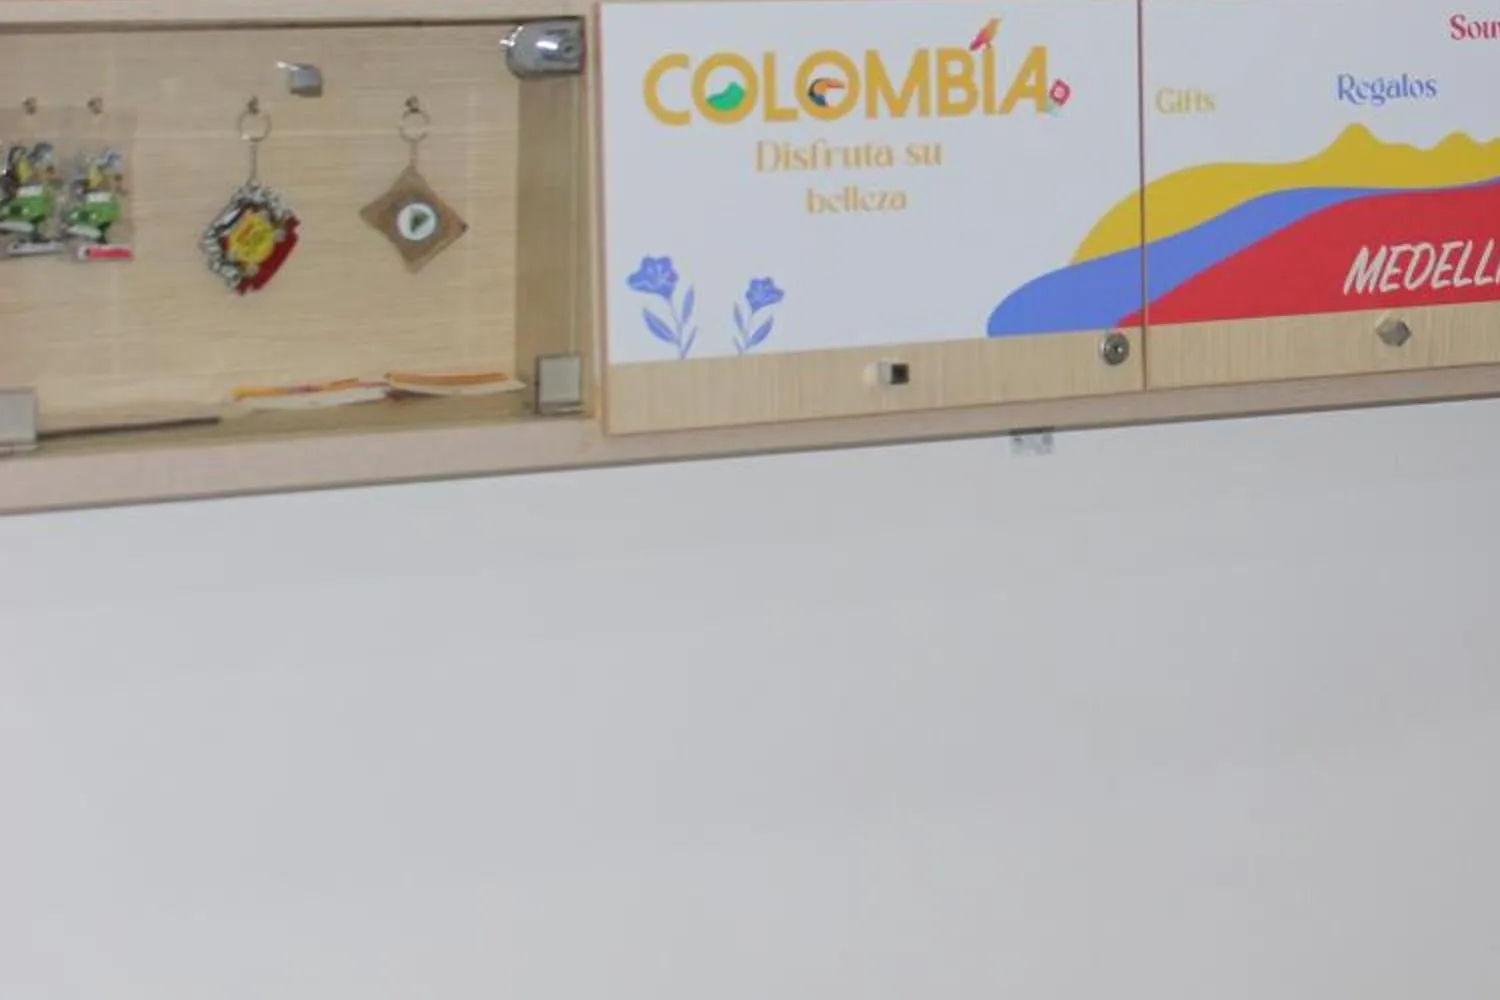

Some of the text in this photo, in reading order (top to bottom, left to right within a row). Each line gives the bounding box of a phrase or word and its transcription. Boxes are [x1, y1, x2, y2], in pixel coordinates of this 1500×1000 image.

[1155, 87, 1216, 115] Gifts
[1337, 73, 1438, 106] Regalos
[756, 138, 942, 173] Disfruta su
[806, 186, 907, 214] belleza
